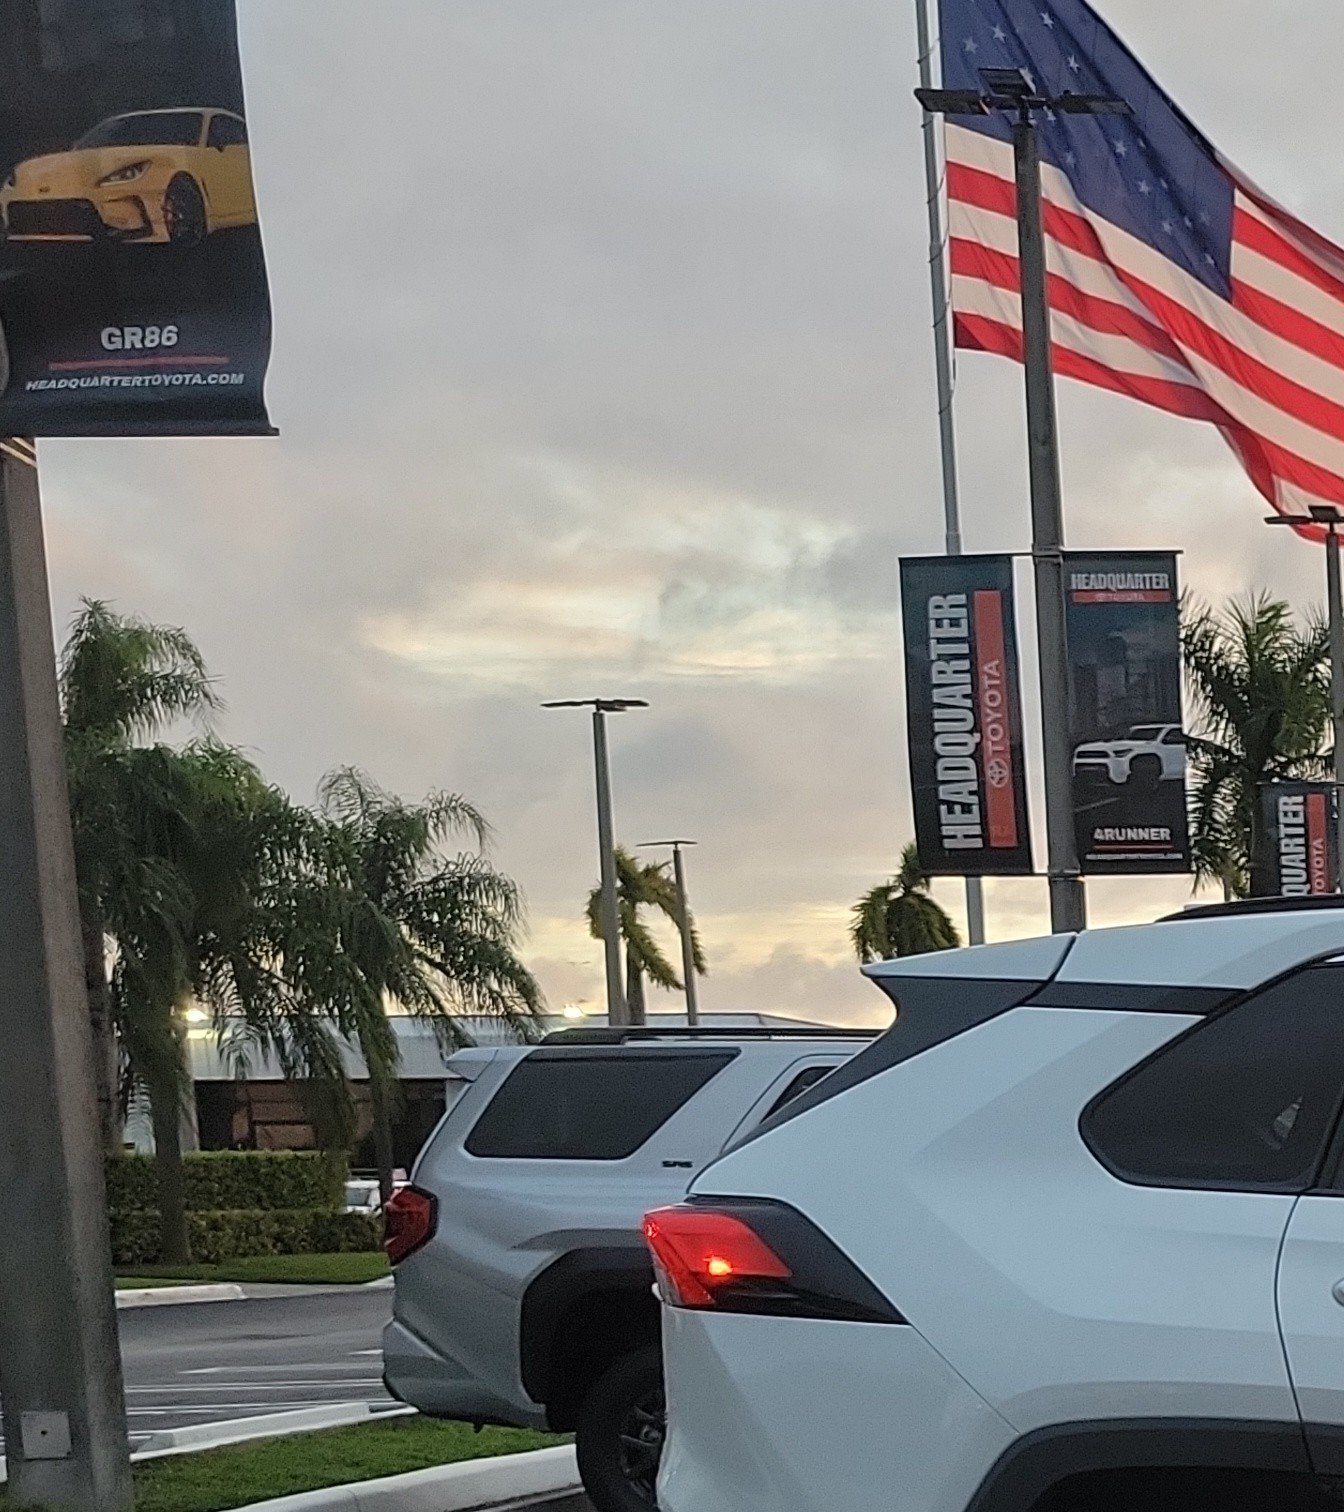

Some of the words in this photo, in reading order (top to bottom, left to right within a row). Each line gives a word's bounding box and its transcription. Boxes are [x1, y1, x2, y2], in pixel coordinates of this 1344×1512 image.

[101, 325, 179, 350] GR86
[25, 373, 245, 391] HEADQUARTERTOYOTA.COM
[1071, 573, 1169, 591] HEADQUARTER
[982, 660, 1006, 758] TOYOTA
[929, 593, 983, 849] HEADQUARTER
[1093, 828, 1171, 840] 4RUNNER
